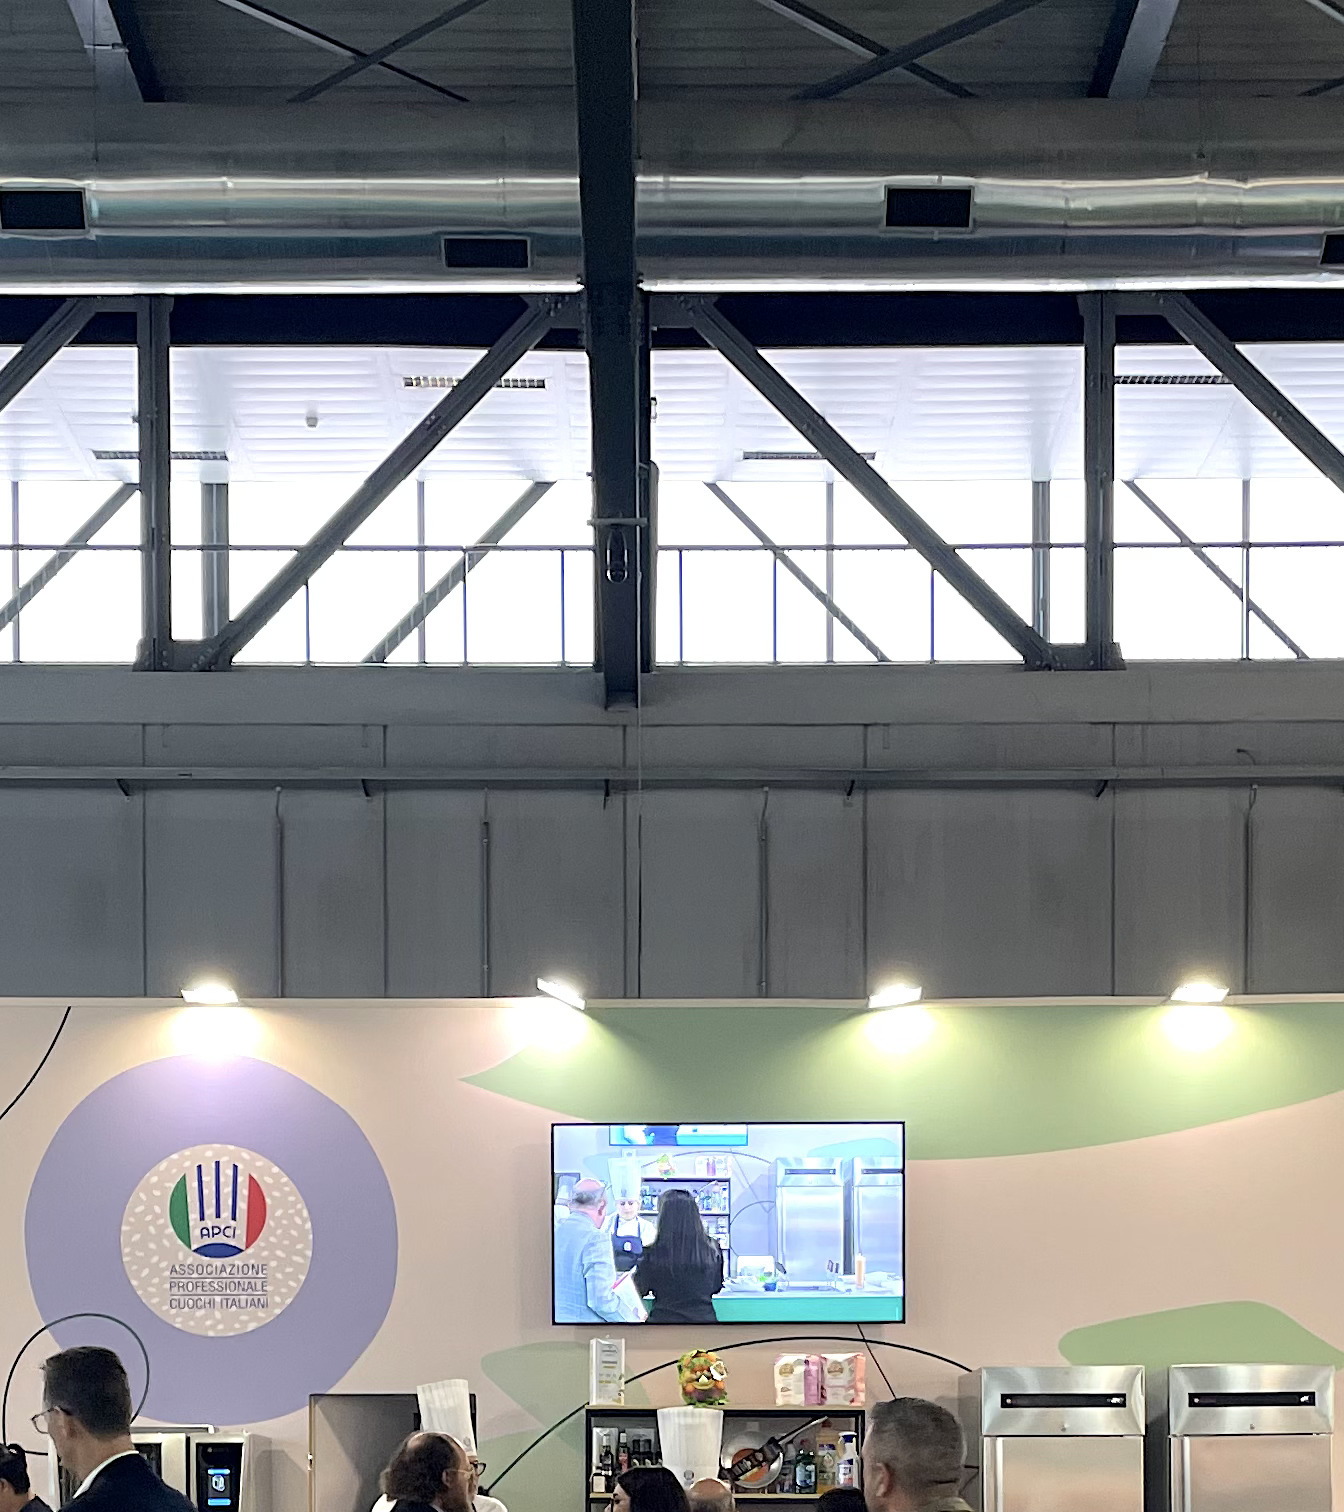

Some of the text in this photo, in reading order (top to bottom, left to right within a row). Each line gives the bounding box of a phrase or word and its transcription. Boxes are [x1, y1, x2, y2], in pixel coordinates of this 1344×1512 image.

[200, 1225, 237, 1239] APCI
[169, 1263, 268, 1276] ASSOCIAZIONE
[169, 1280, 269, 1293] PROFESSIONALE
[169, 1297, 269, 1310] CUOCHI ITALIANI
